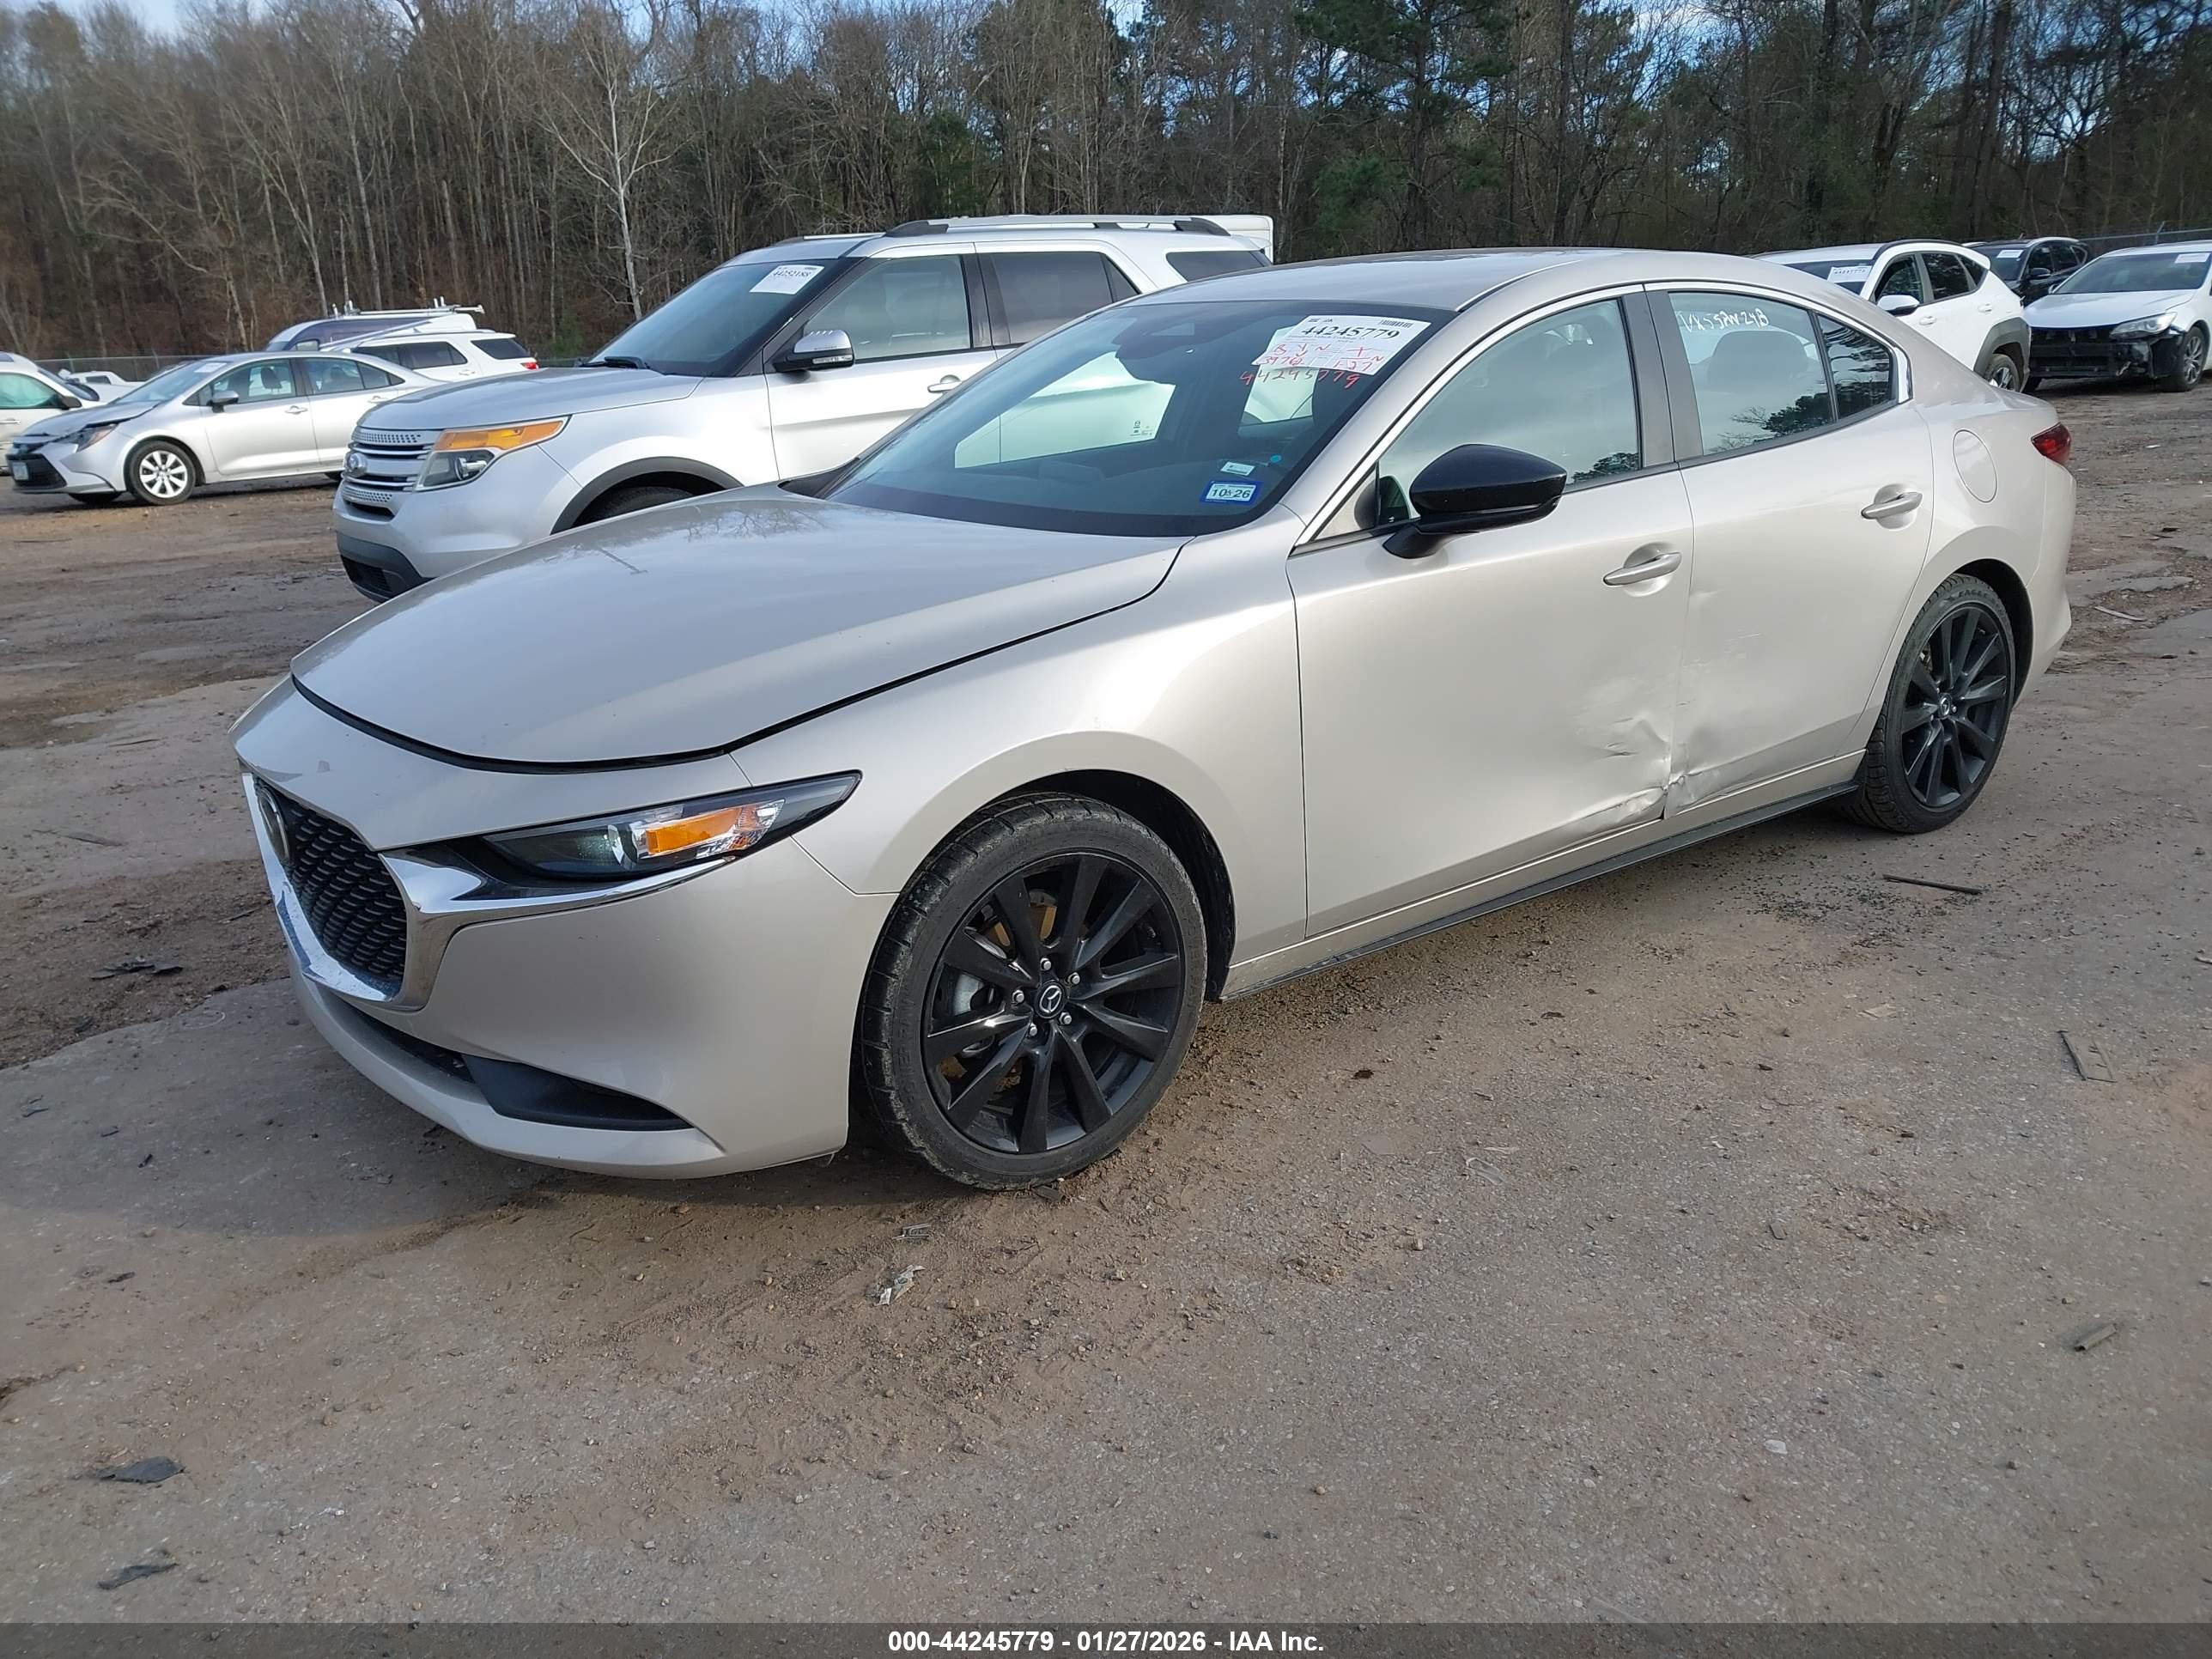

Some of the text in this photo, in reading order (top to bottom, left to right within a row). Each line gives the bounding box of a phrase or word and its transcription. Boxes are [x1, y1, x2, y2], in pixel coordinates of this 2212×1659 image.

[1301, 325, 1400, 339] 44245779
[1212, 489, 1228, 497] 10
[1232, 489, 1251, 498] 26
